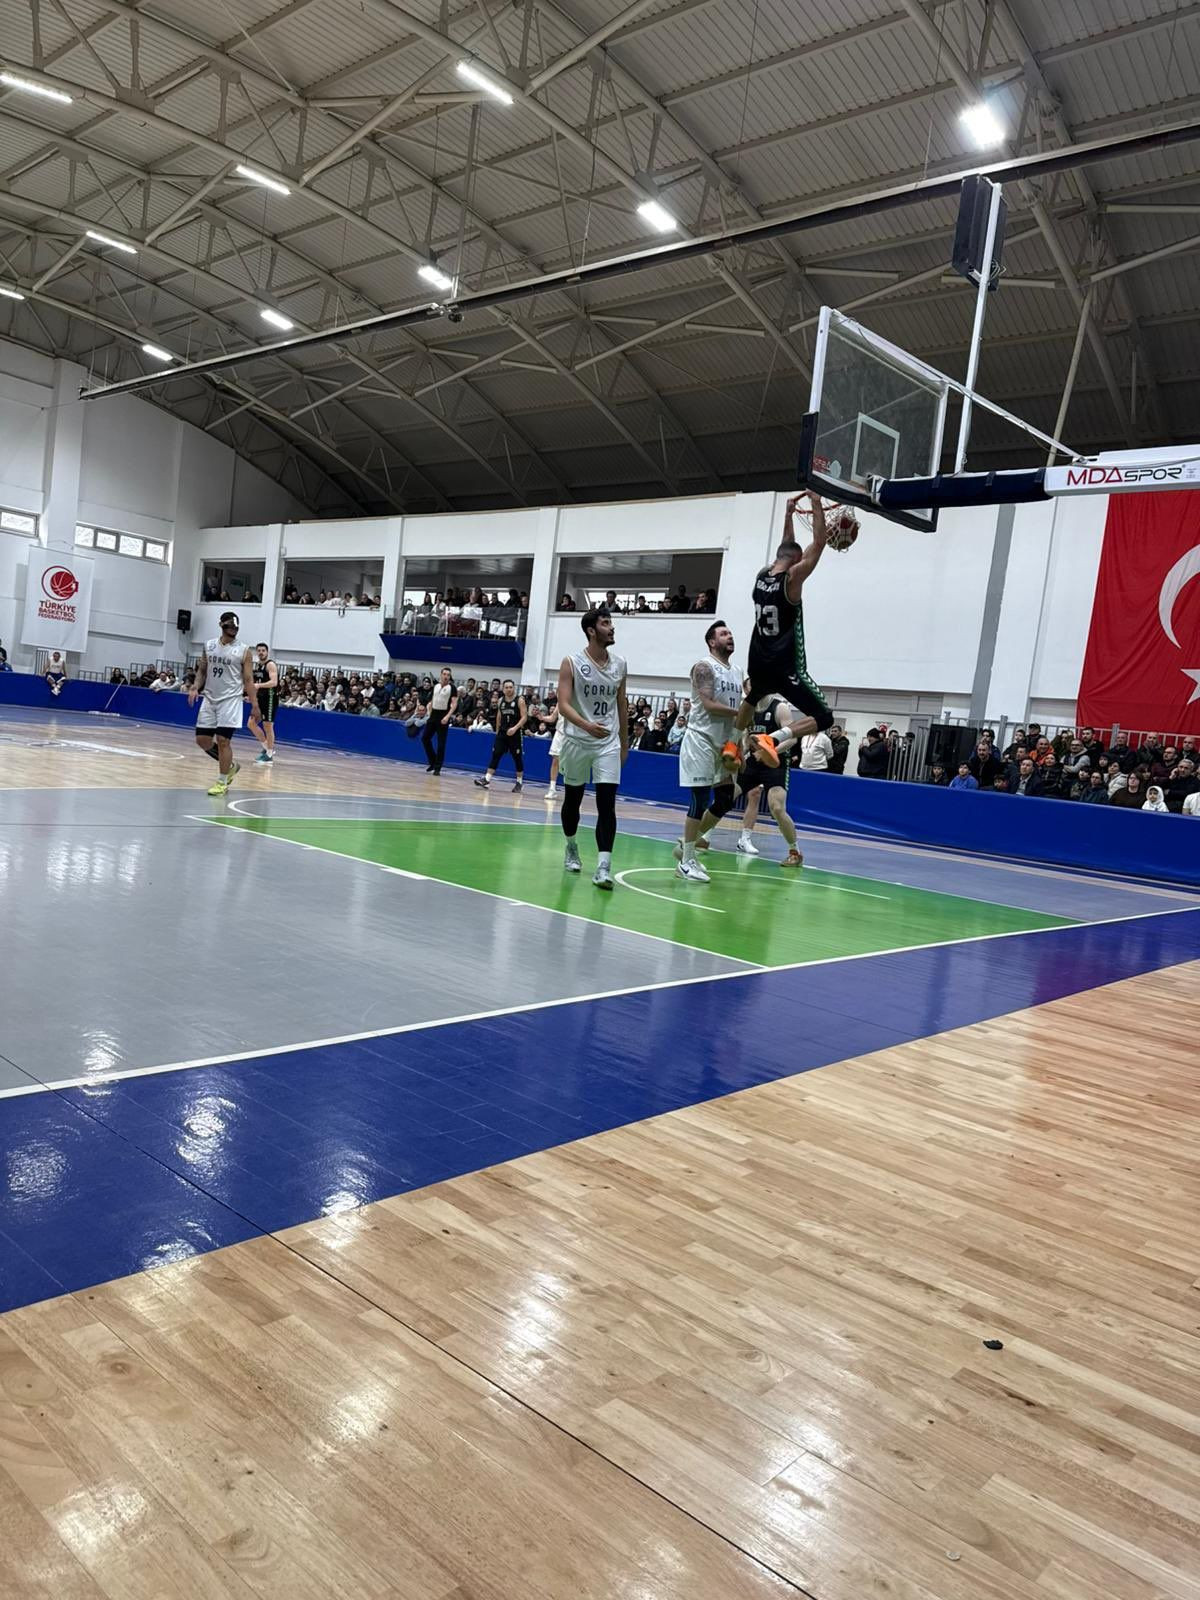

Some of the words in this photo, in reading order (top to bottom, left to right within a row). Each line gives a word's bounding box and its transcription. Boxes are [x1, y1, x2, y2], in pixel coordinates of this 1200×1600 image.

[38, 607, 76, 619] BASKETBOL
[39, 599, 77, 614] TÜRKİYE
[213, 666, 224, 678] 99
[593, 701, 608, 715] 20
